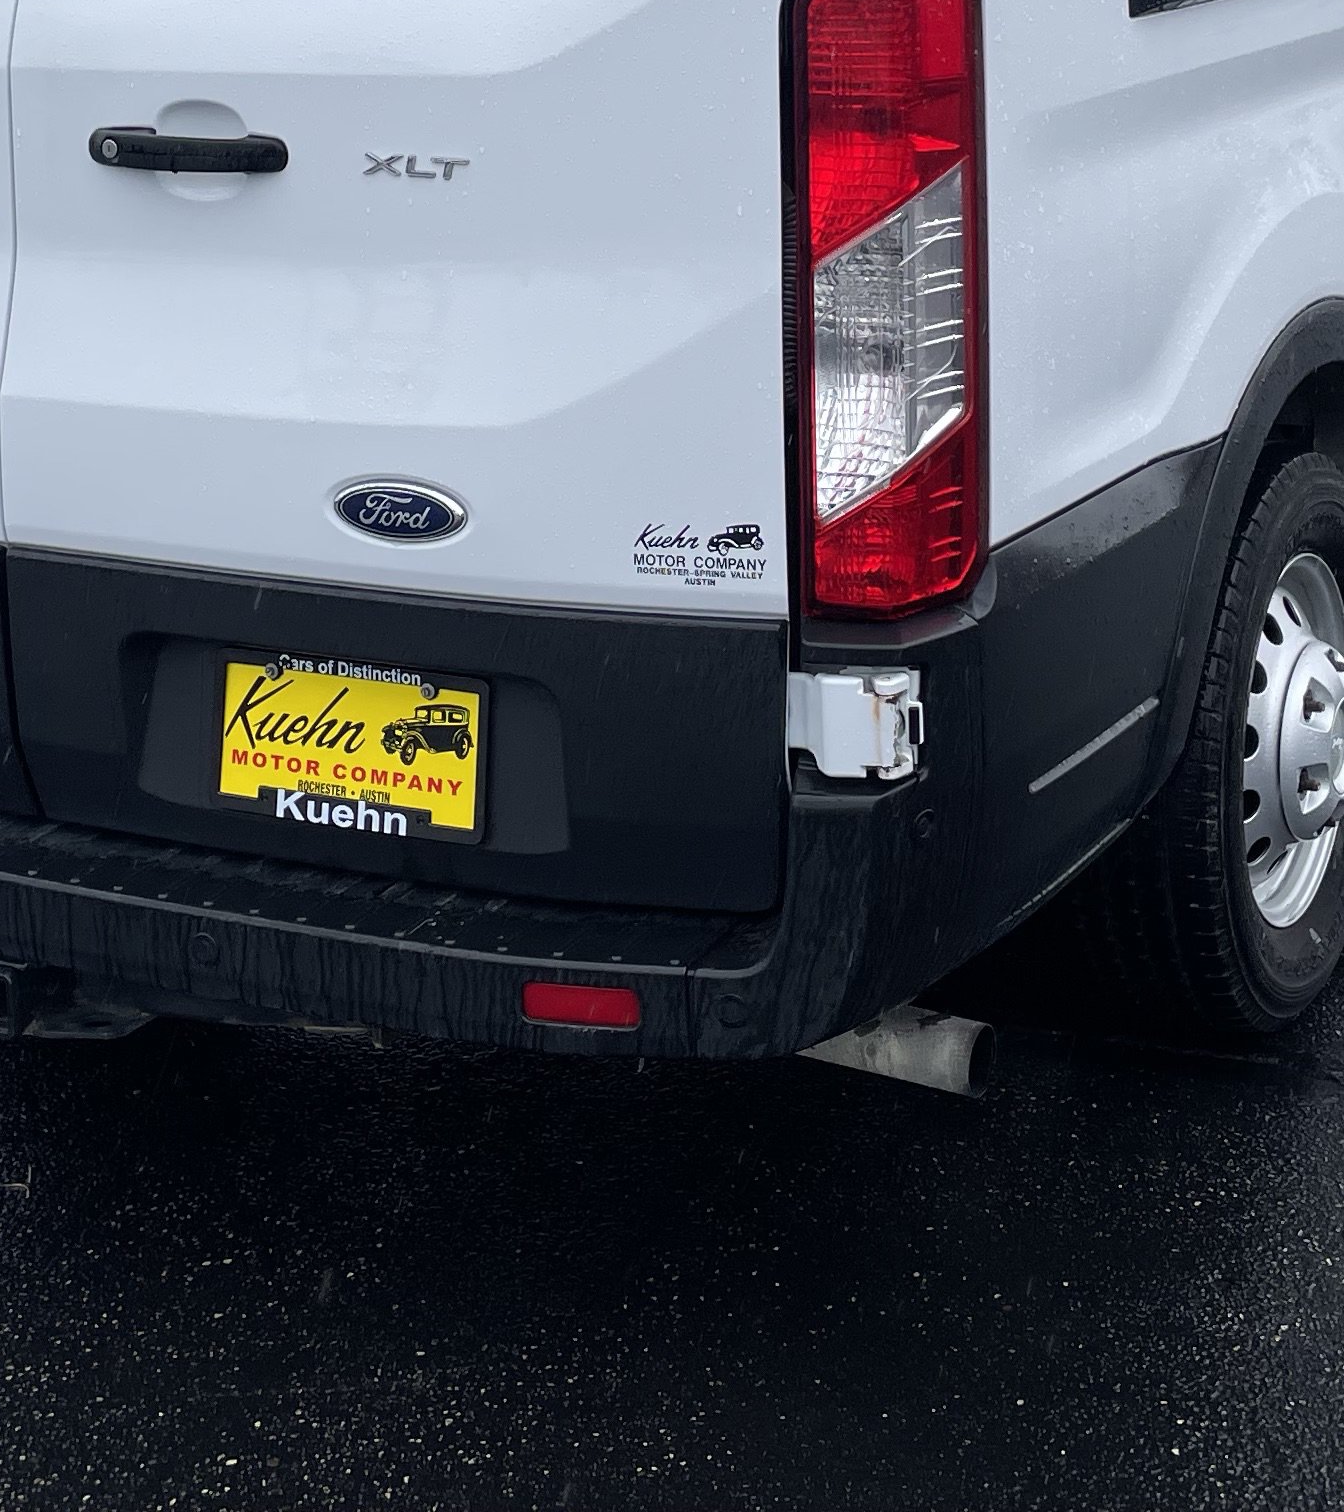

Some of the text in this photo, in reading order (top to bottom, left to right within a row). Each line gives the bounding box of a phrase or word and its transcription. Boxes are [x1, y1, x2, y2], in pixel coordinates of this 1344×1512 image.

[362, 151, 471, 181] XLT
[358, 492, 431, 530] Ford
[634, 523, 700, 551] Kuehn
[633, 553, 767, 572] MOTOR COMPANY
[730, 570, 763, 580] VALLEY
[684, 577, 716, 586] AUSTIN
[278, 653, 422, 687] Cars of Distinction
[225, 675, 366, 755] Kuehn
[231, 748, 464, 797] MOTOR COMPANY
[297, 779, 391, 805] ROCHESTER AUSTIN
[275, 788, 408, 837] Kuehn
